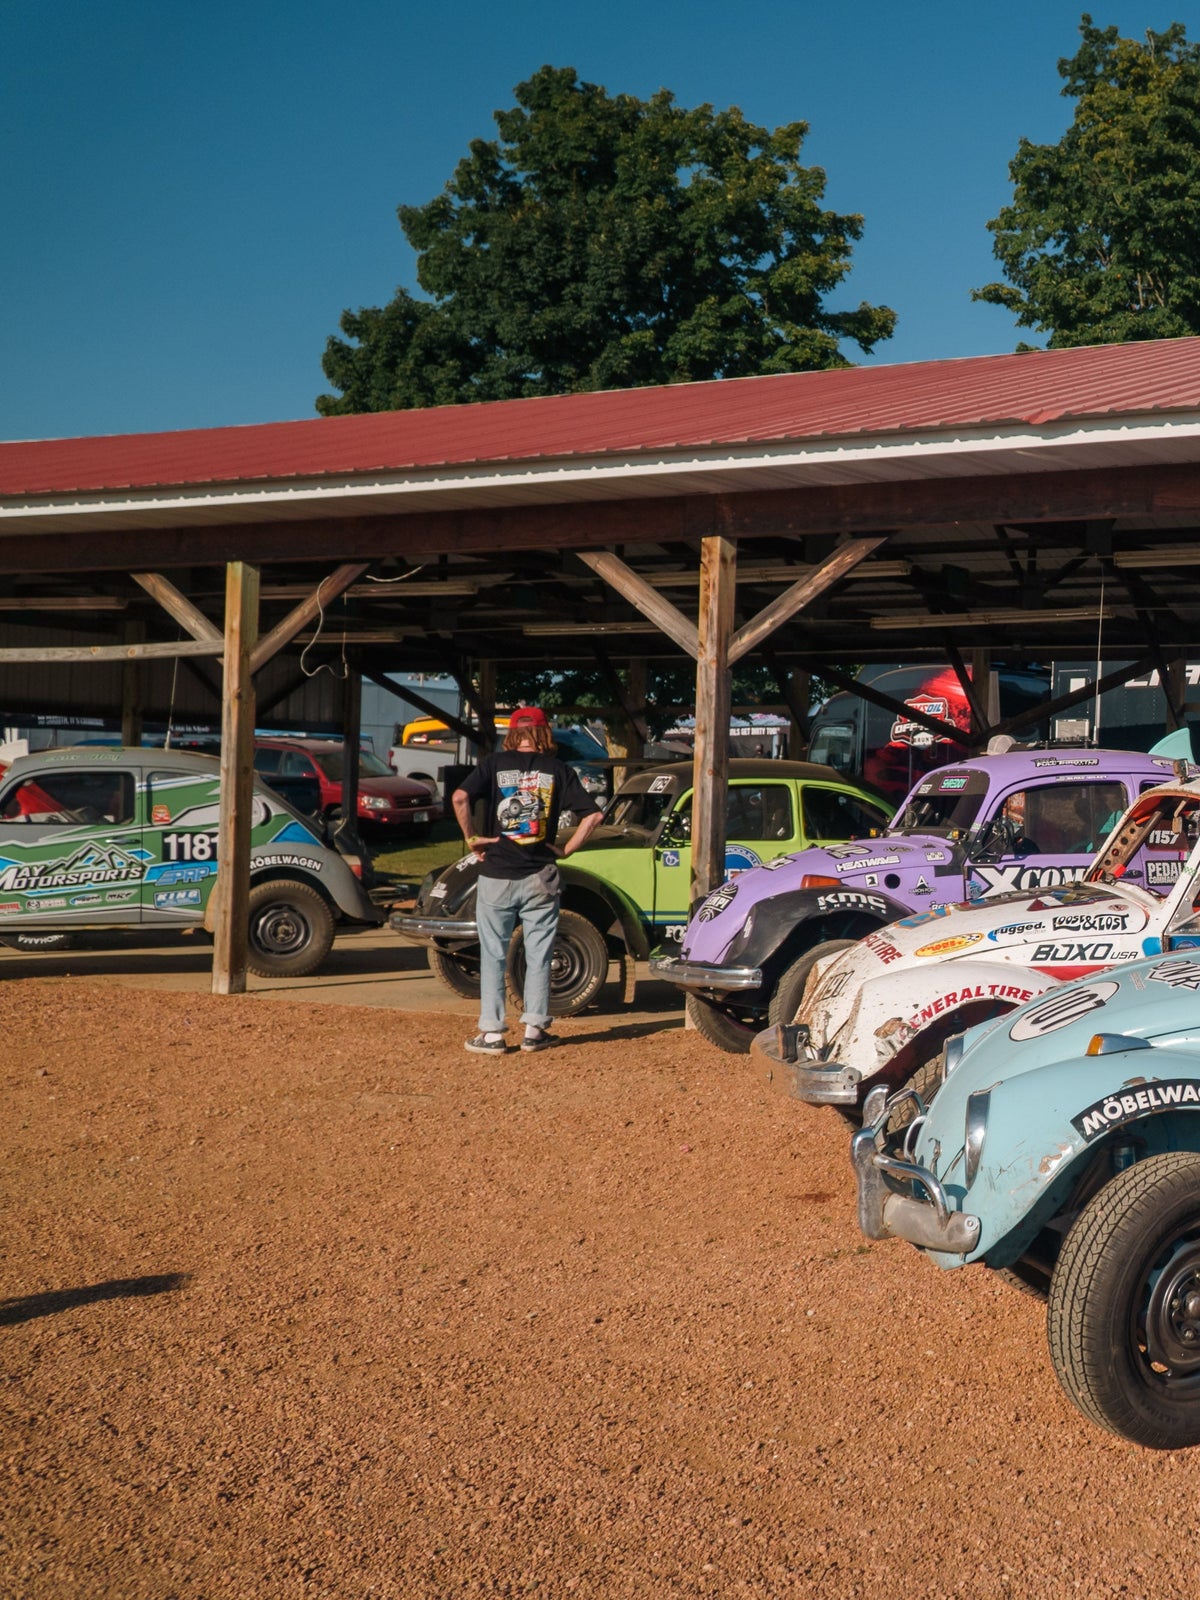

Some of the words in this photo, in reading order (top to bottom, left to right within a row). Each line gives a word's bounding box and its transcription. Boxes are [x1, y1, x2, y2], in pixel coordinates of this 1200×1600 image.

[836, 855, 900, 872] HEATWAVE
[157, 890, 199, 901] KING
[817, 892, 887, 910] KMC
[1030, 943, 1114, 962] BOXO
[1110, 951, 1139, 960] USA
[986, 984, 1034, 1002] TIRE
